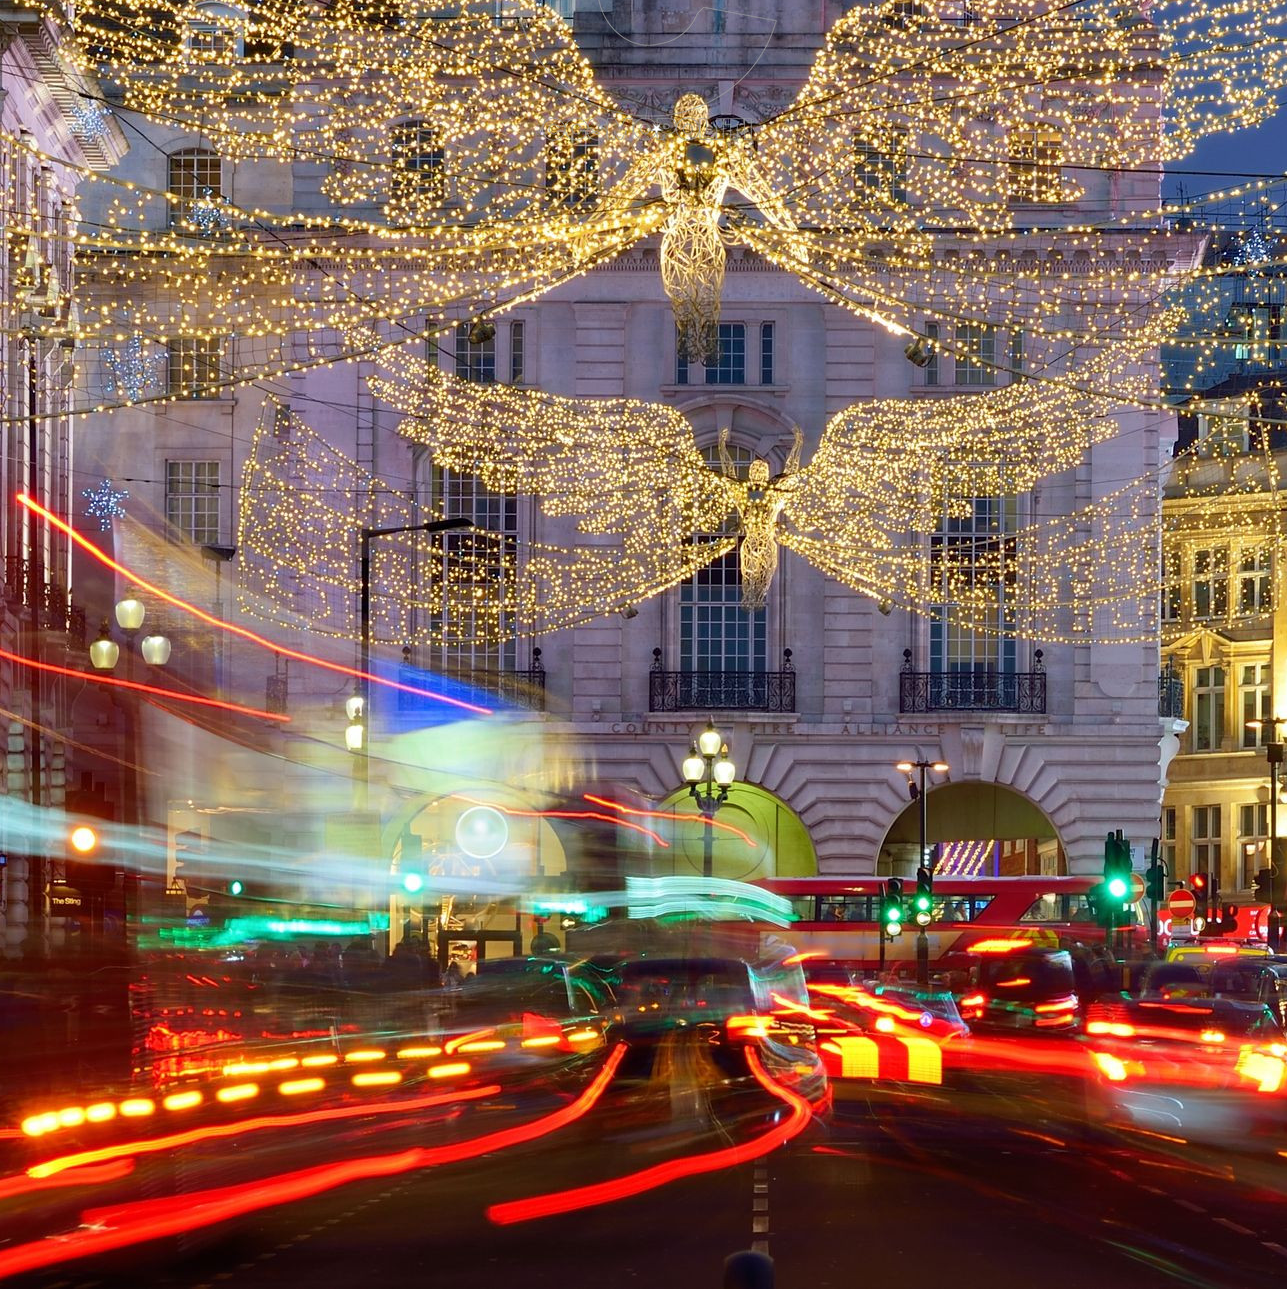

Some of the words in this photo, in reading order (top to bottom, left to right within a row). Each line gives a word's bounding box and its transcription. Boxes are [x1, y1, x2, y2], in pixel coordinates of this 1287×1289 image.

[612, 724, 695, 734] COUNTY
[750, 724, 794, 734] FIRE
[841, 725, 946, 735] ALLIANCE
[1000, 725, 1046, 735] LIFE
[65, 897, 81, 906] Sting
